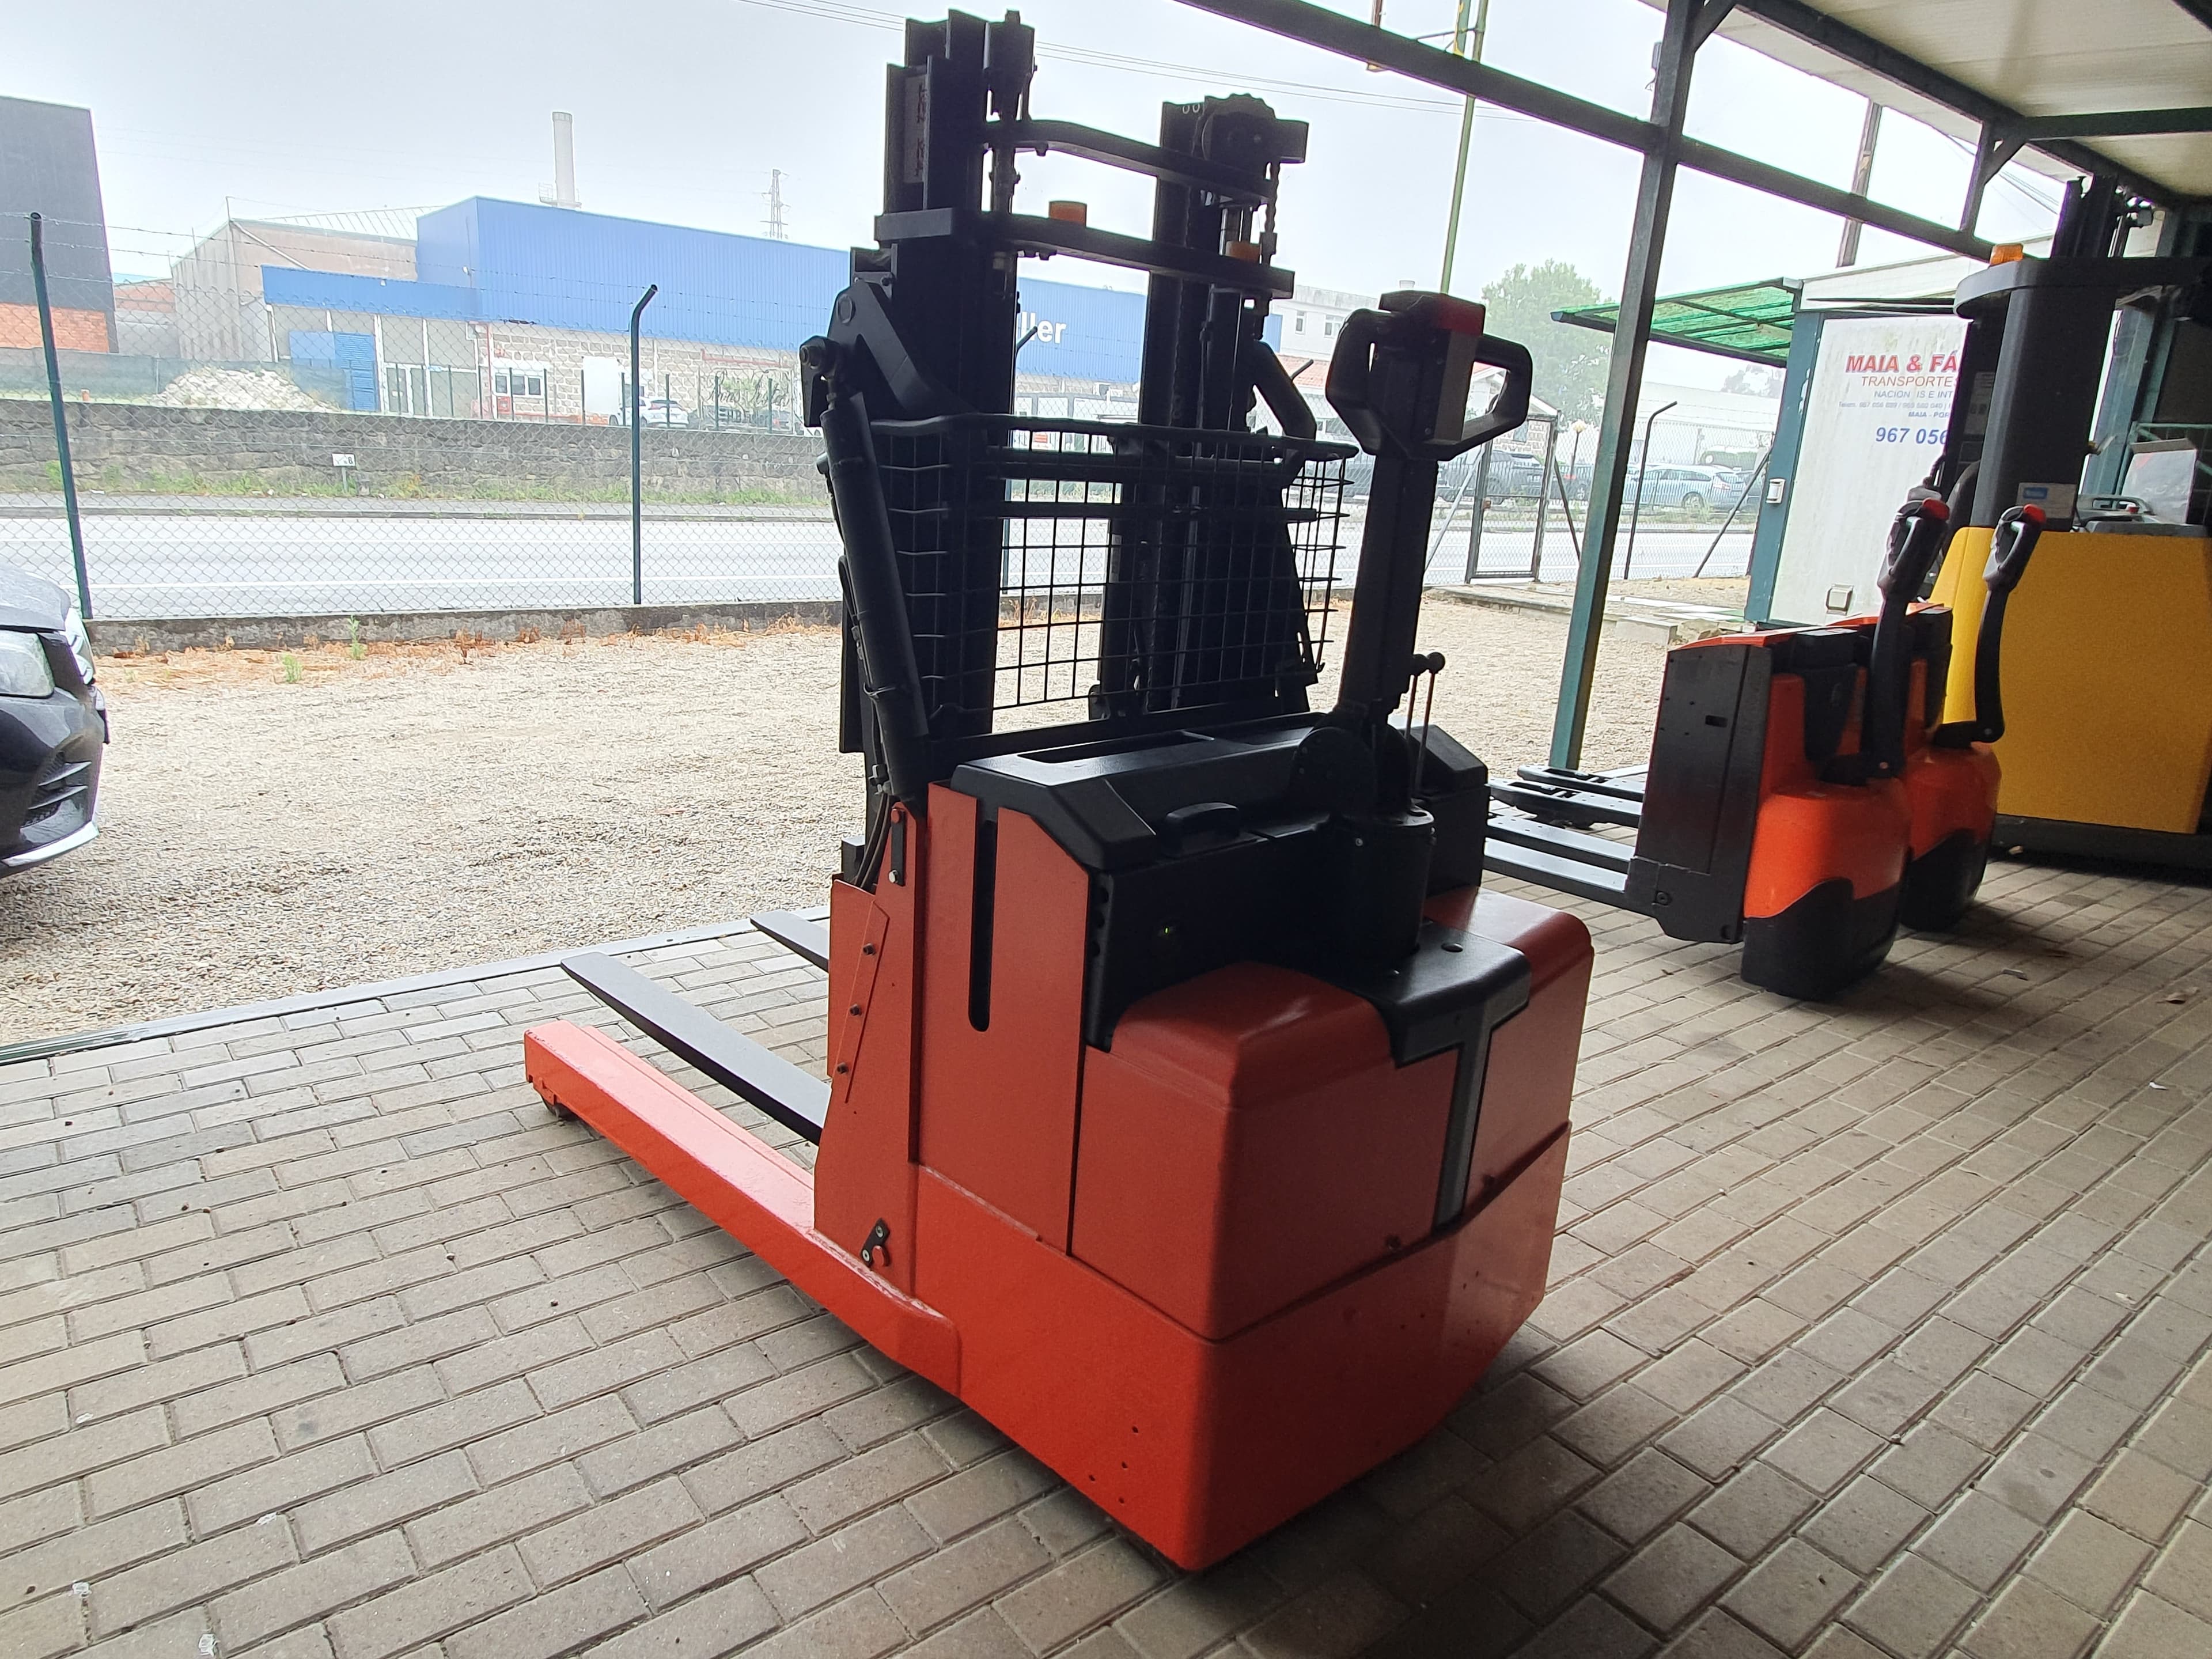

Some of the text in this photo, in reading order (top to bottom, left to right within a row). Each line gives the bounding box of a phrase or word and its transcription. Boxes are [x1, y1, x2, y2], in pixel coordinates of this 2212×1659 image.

[1016, 312, 1067, 344] ller
[1845, 354, 1899, 373] MAIA
[1906, 354, 1922, 373] &
[1861, 376, 1957, 387] TRANSPORTE
[1876, 427, 1947, 445] 967 056
